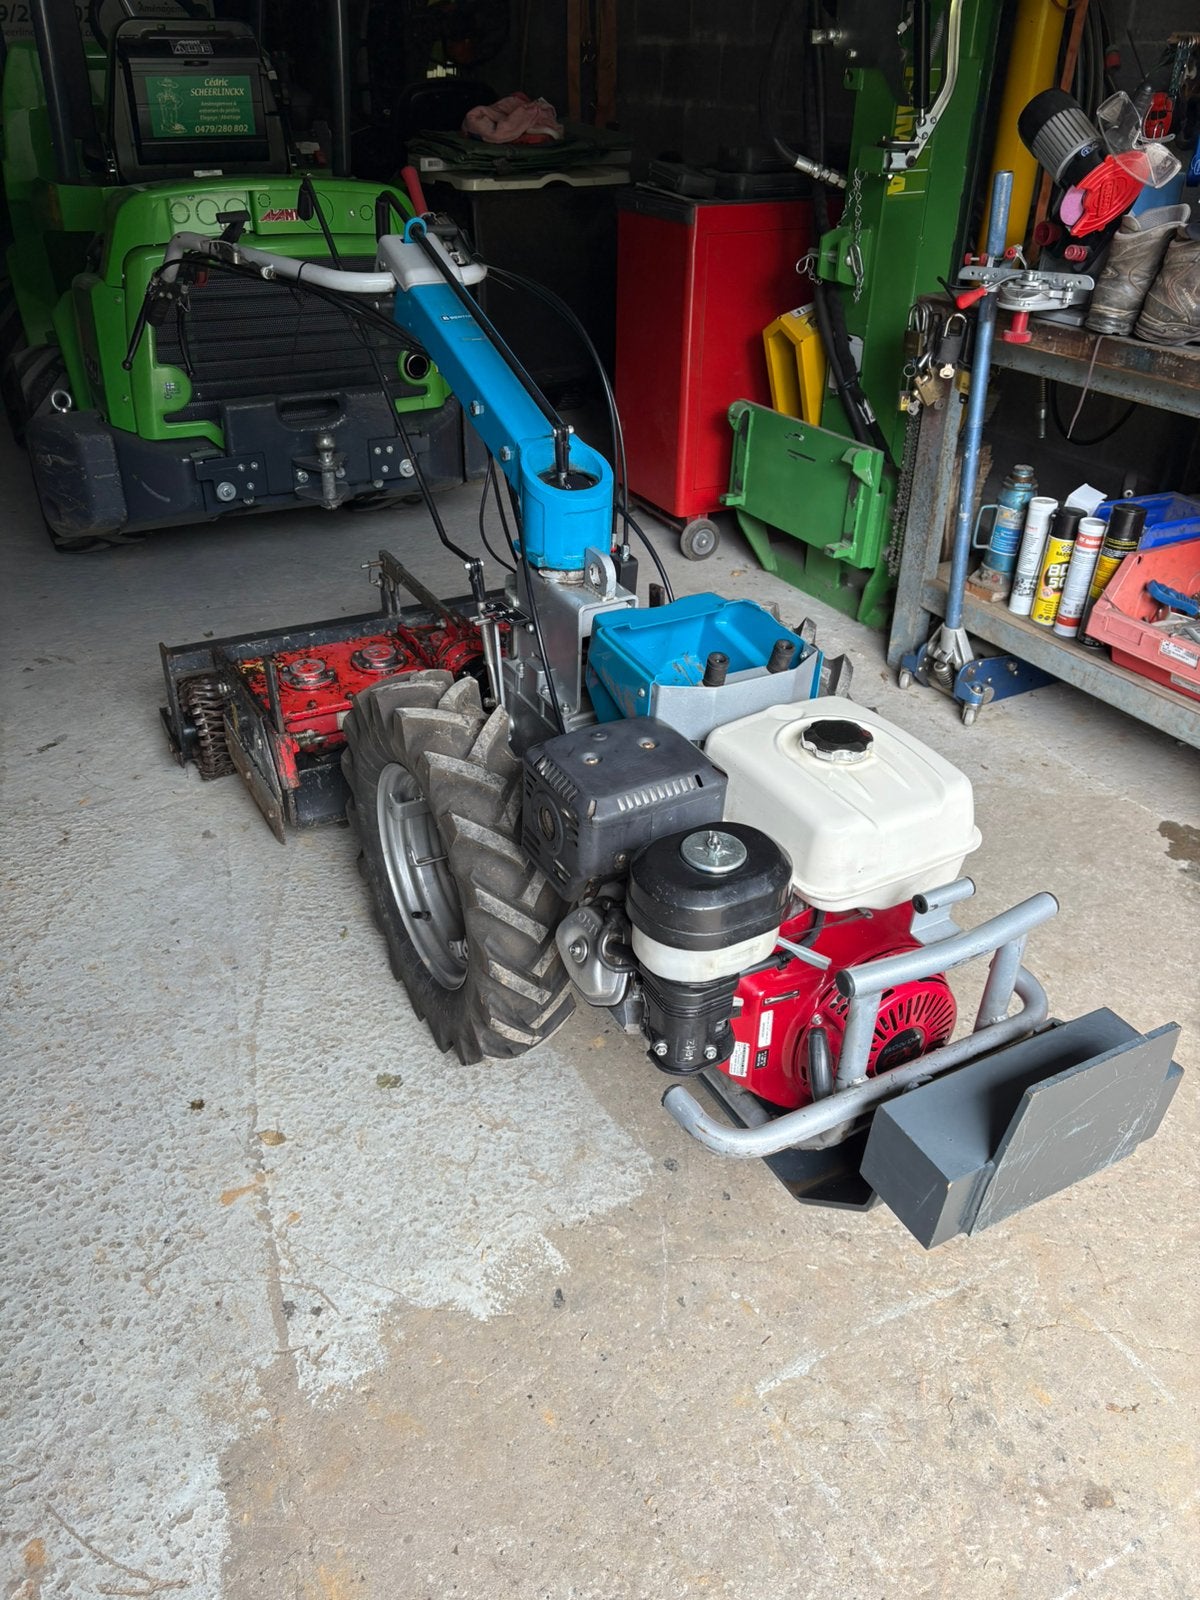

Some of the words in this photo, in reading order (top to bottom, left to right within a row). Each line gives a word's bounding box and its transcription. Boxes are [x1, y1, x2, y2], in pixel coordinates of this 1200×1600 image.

[204, 78, 229, 87] Cédric
[190, 87, 245, 97] SCHEERLINCKX
[195, 125, 233, 133] 0479/280
[234, 124, 249, 133] 802
